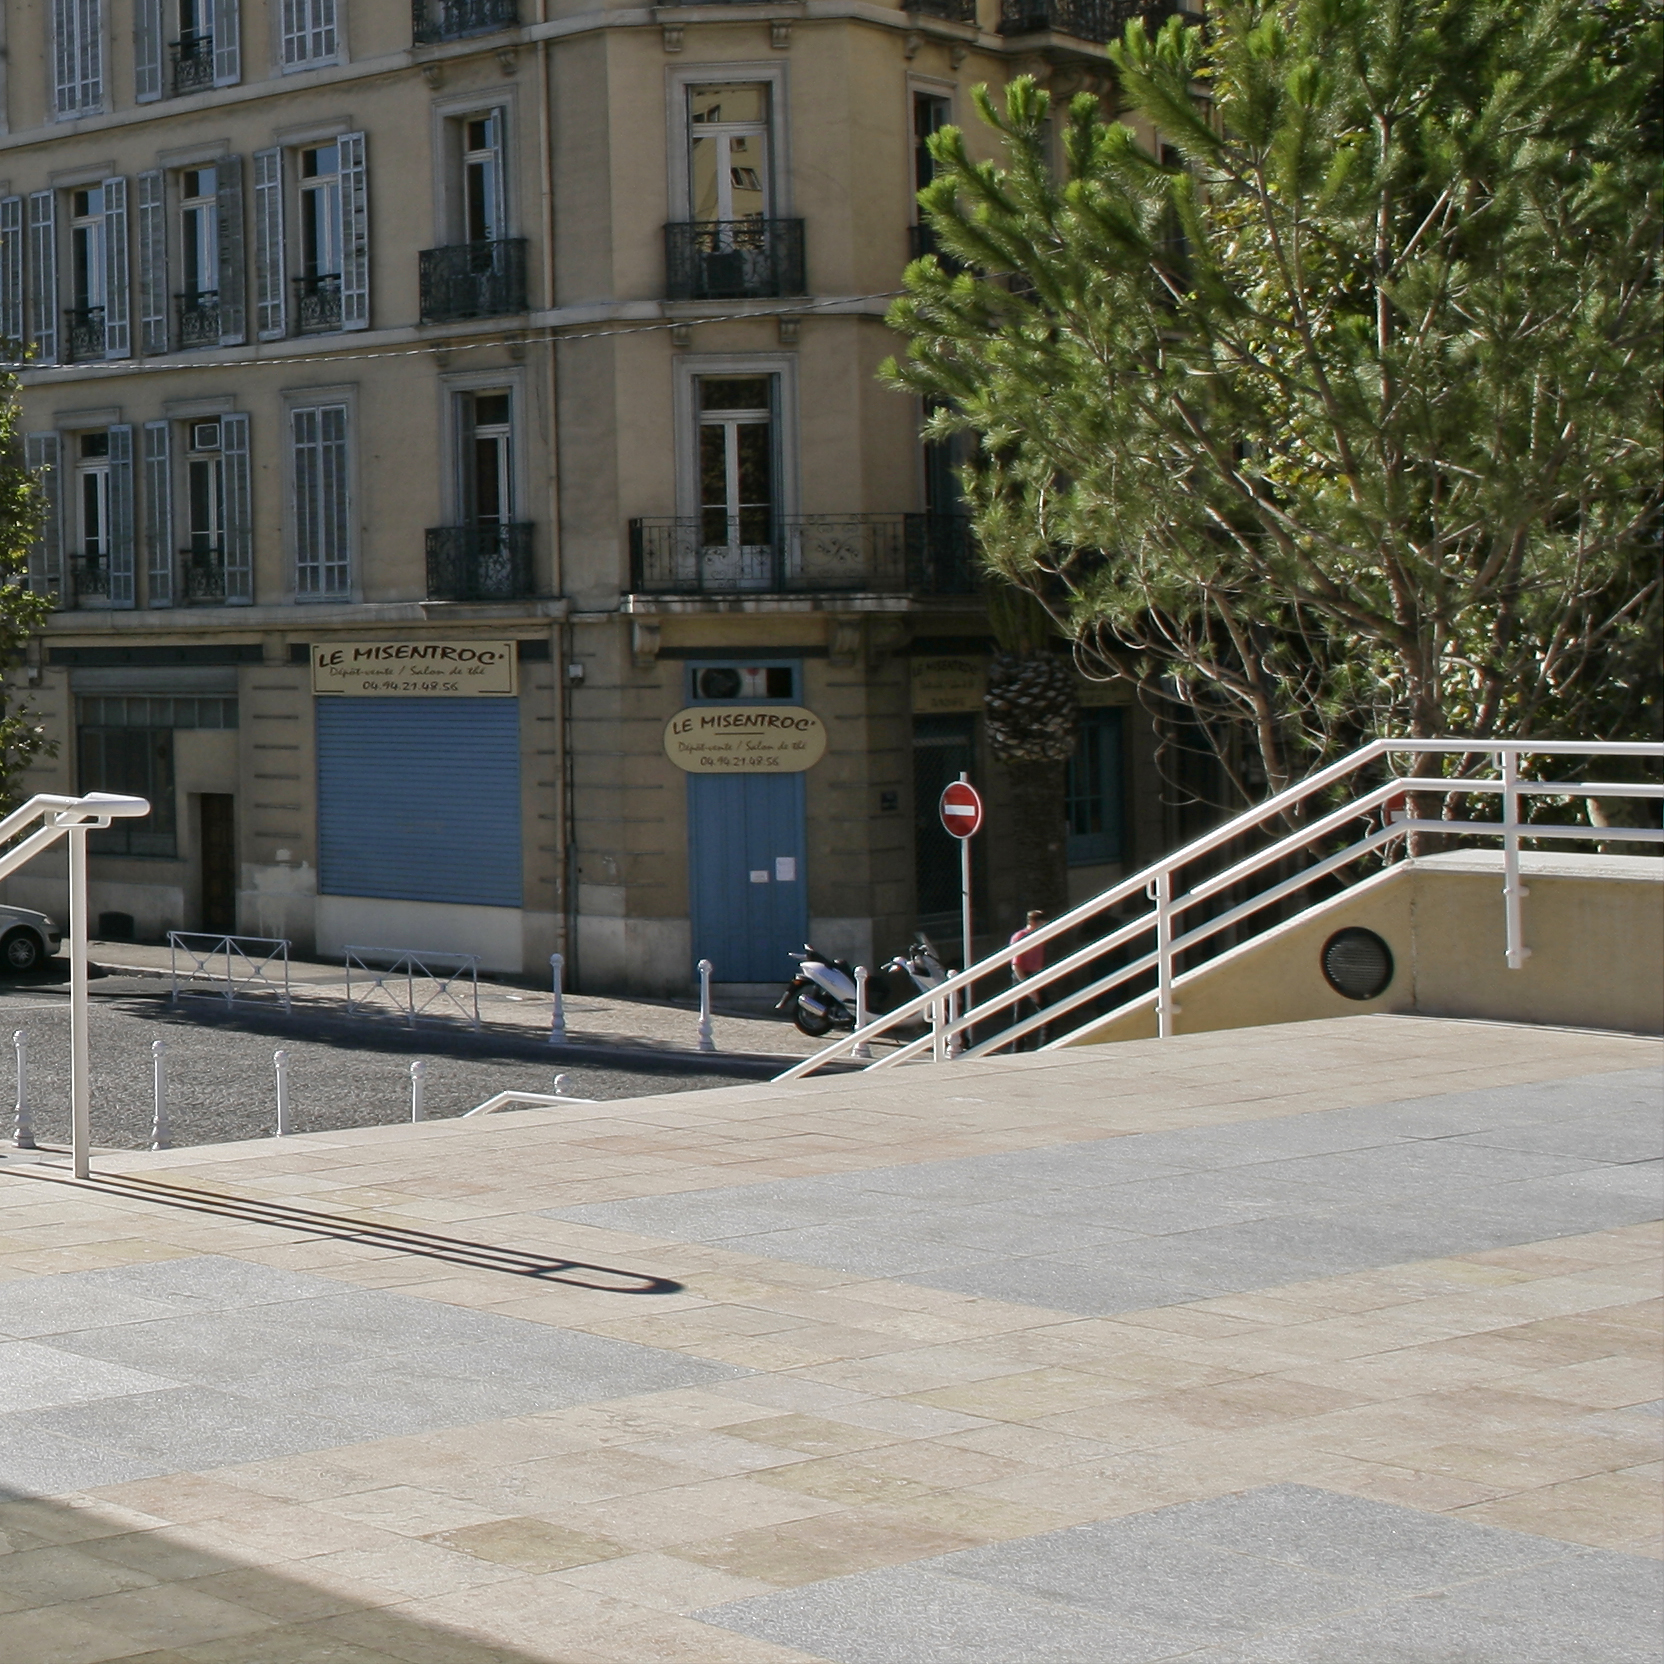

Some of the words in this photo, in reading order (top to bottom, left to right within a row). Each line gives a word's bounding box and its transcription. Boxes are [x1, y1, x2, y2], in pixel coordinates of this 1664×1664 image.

[319, 650, 344, 668] LE
[329, 666, 395, 678] Dépôt-vente
[410, 665, 445, 676] Salon
[449, 666, 463, 676] de
[673, 718, 693, 735] LE
[746, 740, 774, 751] Salon
[777, 741, 789, 751] de
